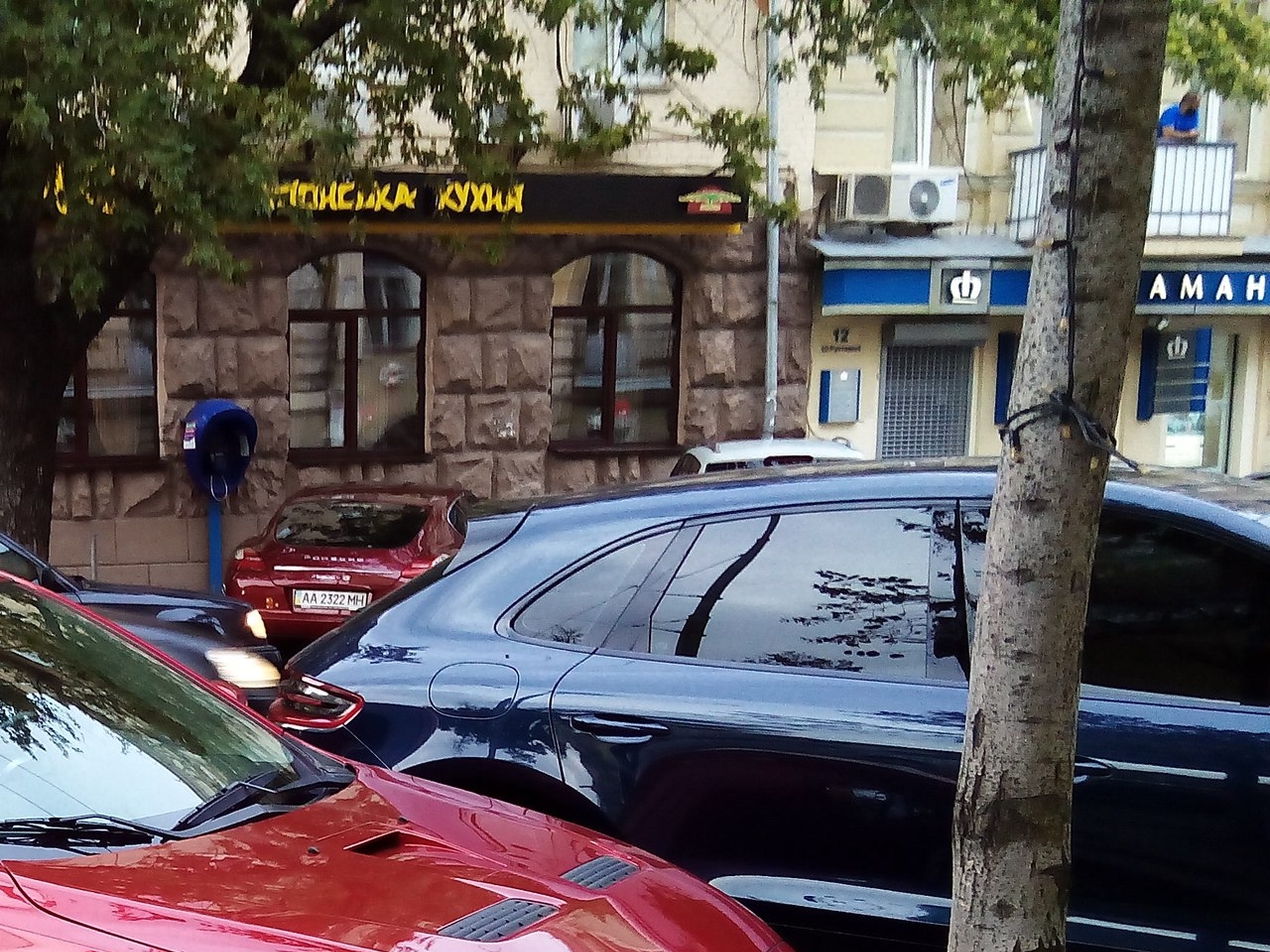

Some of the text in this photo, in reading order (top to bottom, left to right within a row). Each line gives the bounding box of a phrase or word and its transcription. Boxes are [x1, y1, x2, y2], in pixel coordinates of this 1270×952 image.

[302, 592, 365, 607] AA 2322 MH
